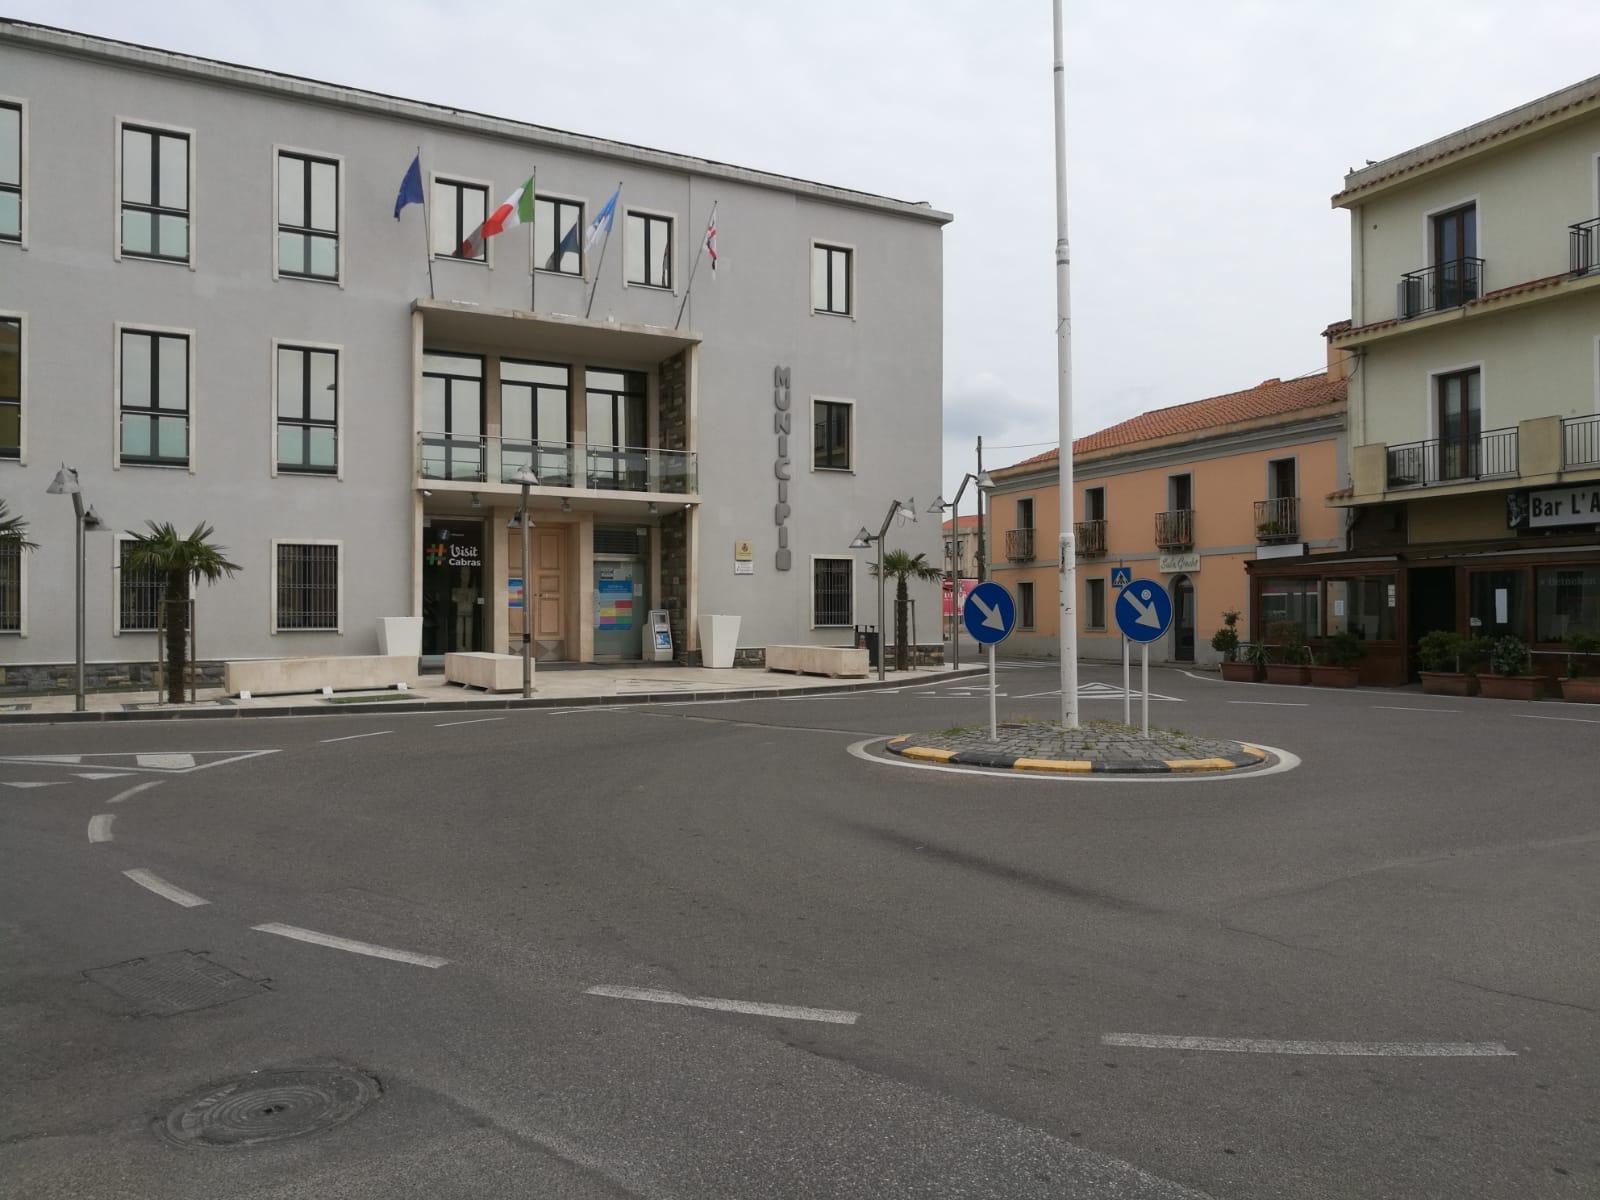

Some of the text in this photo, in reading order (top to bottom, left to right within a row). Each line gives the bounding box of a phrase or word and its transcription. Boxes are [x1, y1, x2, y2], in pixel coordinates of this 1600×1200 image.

[774, 365, 791, 571] MUNICIPIO
[1532, 497, 1562, 517] Bar
[450, 544, 478, 557] Visit
[449, 558, 481, 567] Cabras
